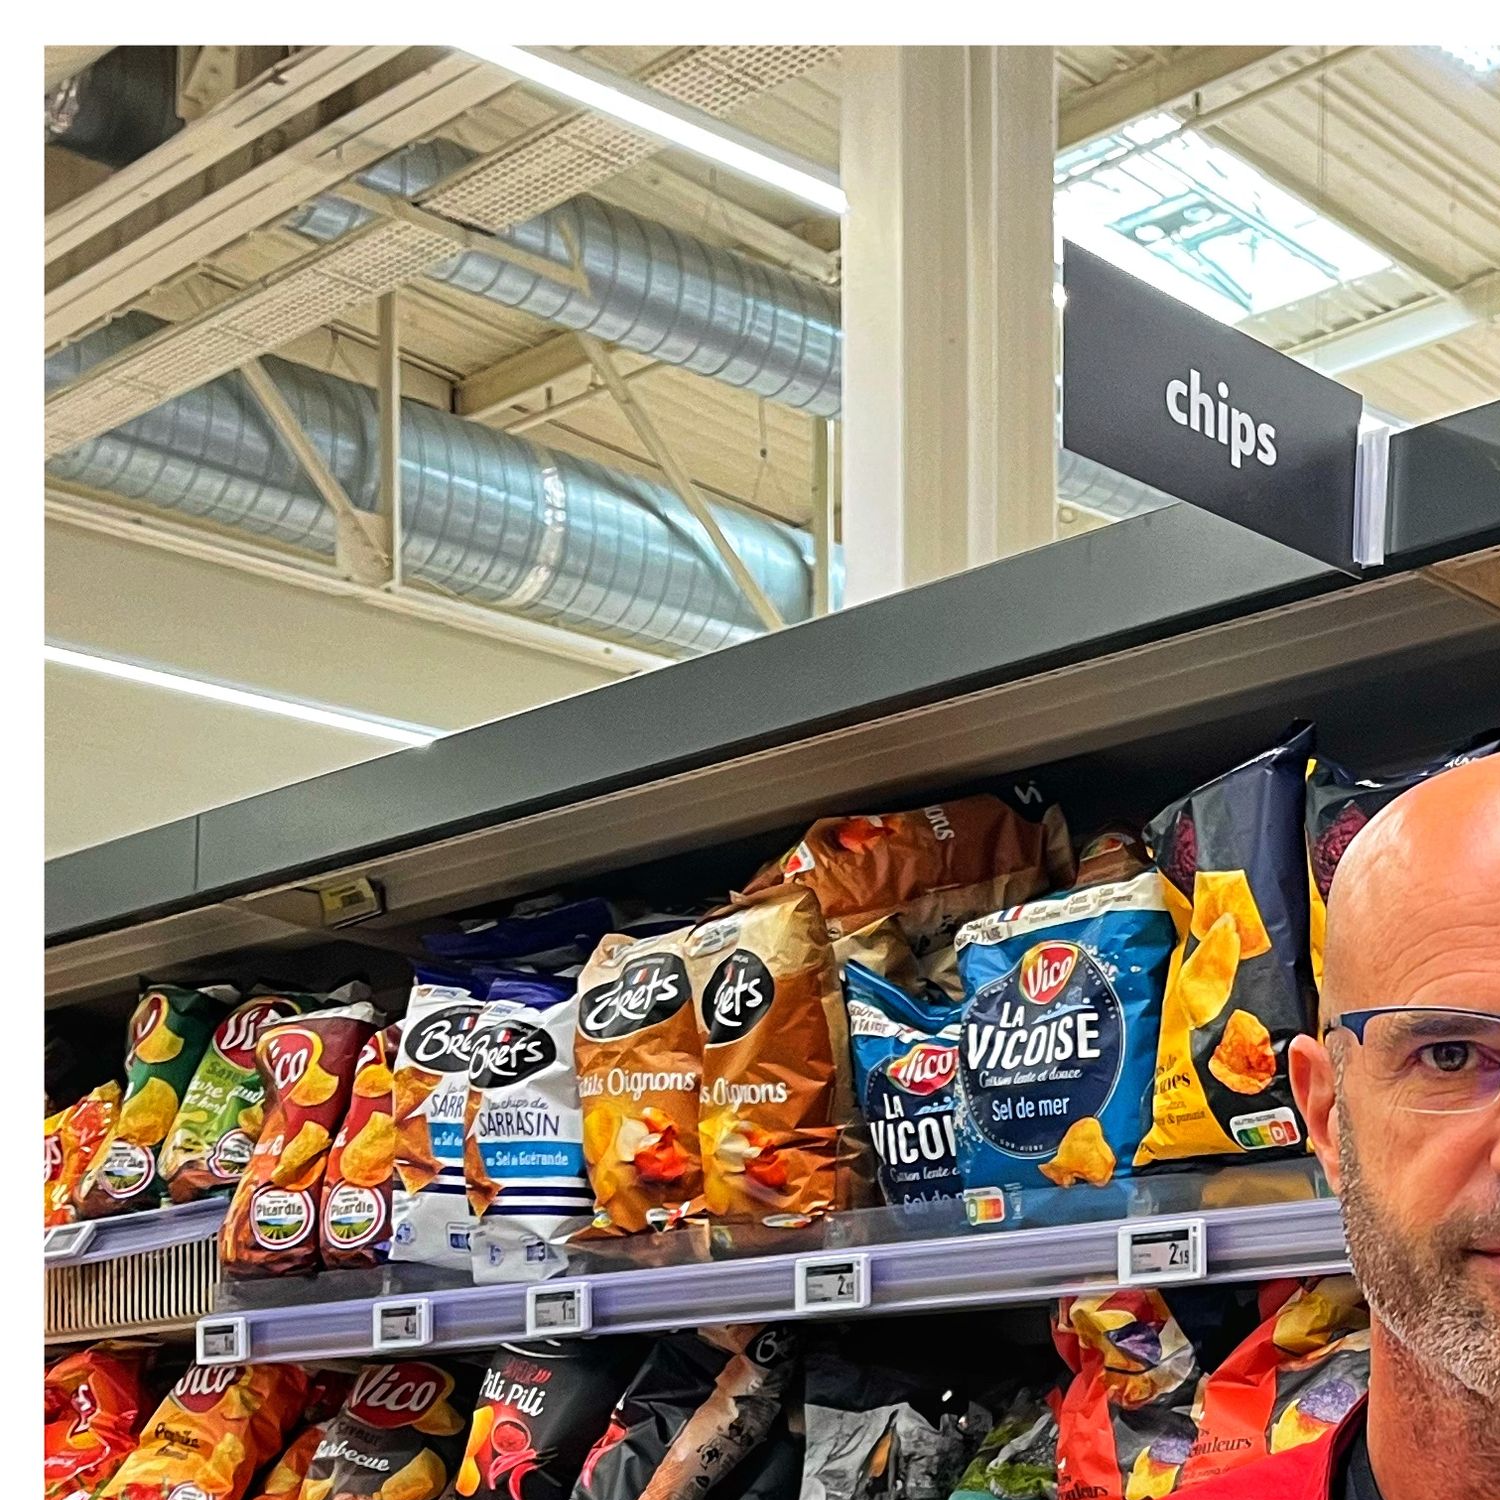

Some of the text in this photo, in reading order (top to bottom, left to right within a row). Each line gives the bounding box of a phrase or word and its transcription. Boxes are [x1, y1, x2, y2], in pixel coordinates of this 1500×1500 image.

[1166, 368, 1277, 469] chips
[1028, 955, 1072, 998] Vico
[1001, 1002, 1025, 1028] LA
[967, 1012, 1100, 1070] VICOISE
[607, 1068, 696, 1101] Oignons
[899, 1050, 953, 1087] Vico
[431, 1093, 464, 1118] SARR
[883, 1093, 904, 1120] LA
[992, 1097, 1070, 1121] Sel de mer
[479, 1111, 560, 1137] SARRASIN
[870, 1115, 957, 1165] VICOI
[352, 1364, 437, 1411] Vico
[504, 1384, 546, 1417] Pili
